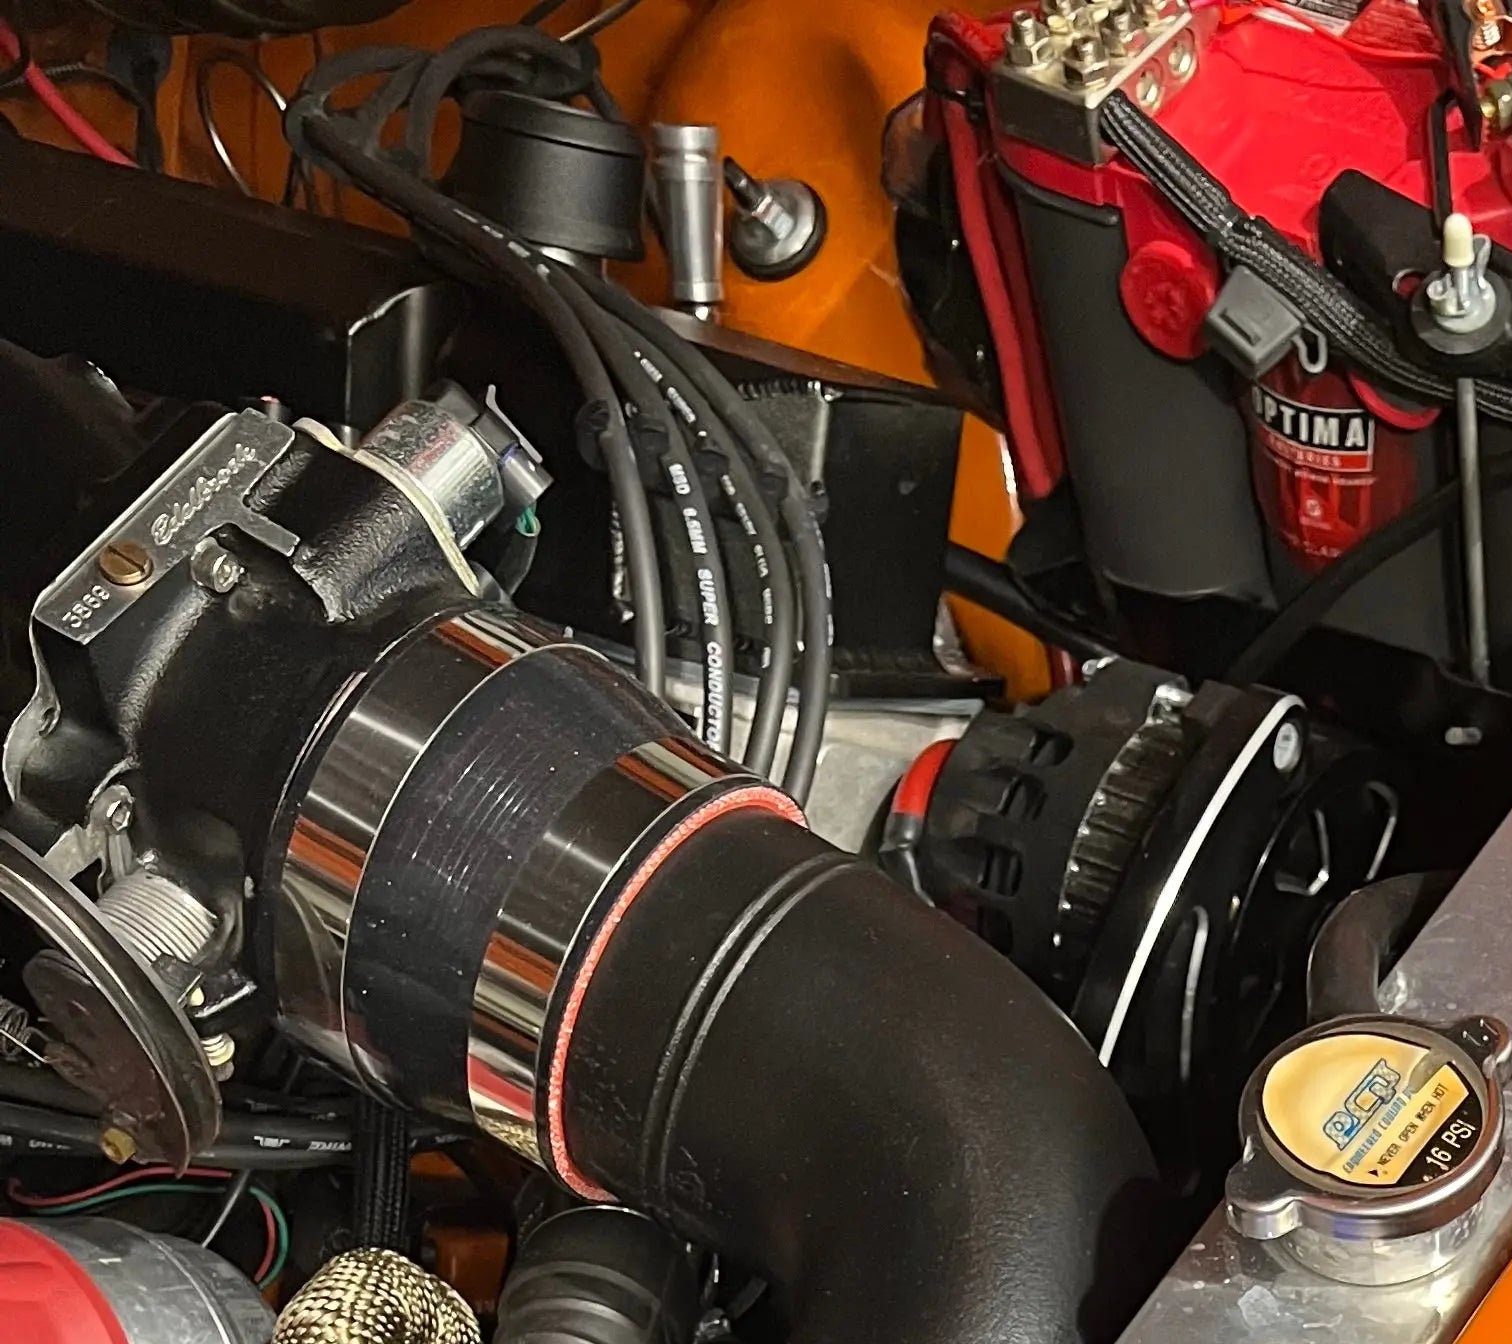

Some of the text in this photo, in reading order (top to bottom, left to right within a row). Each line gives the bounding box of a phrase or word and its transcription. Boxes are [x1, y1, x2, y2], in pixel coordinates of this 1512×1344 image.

[697, 568, 719, 627] SUPER
[1377, 1141, 1402, 1167] NEVER
[1399, 1122, 1420, 1143] OPEN
[1416, 1101, 1437, 1124] WHEN
[1432, 1082, 1449, 1105] HOT
[1425, 1119, 1477, 1172] 16 PSI
